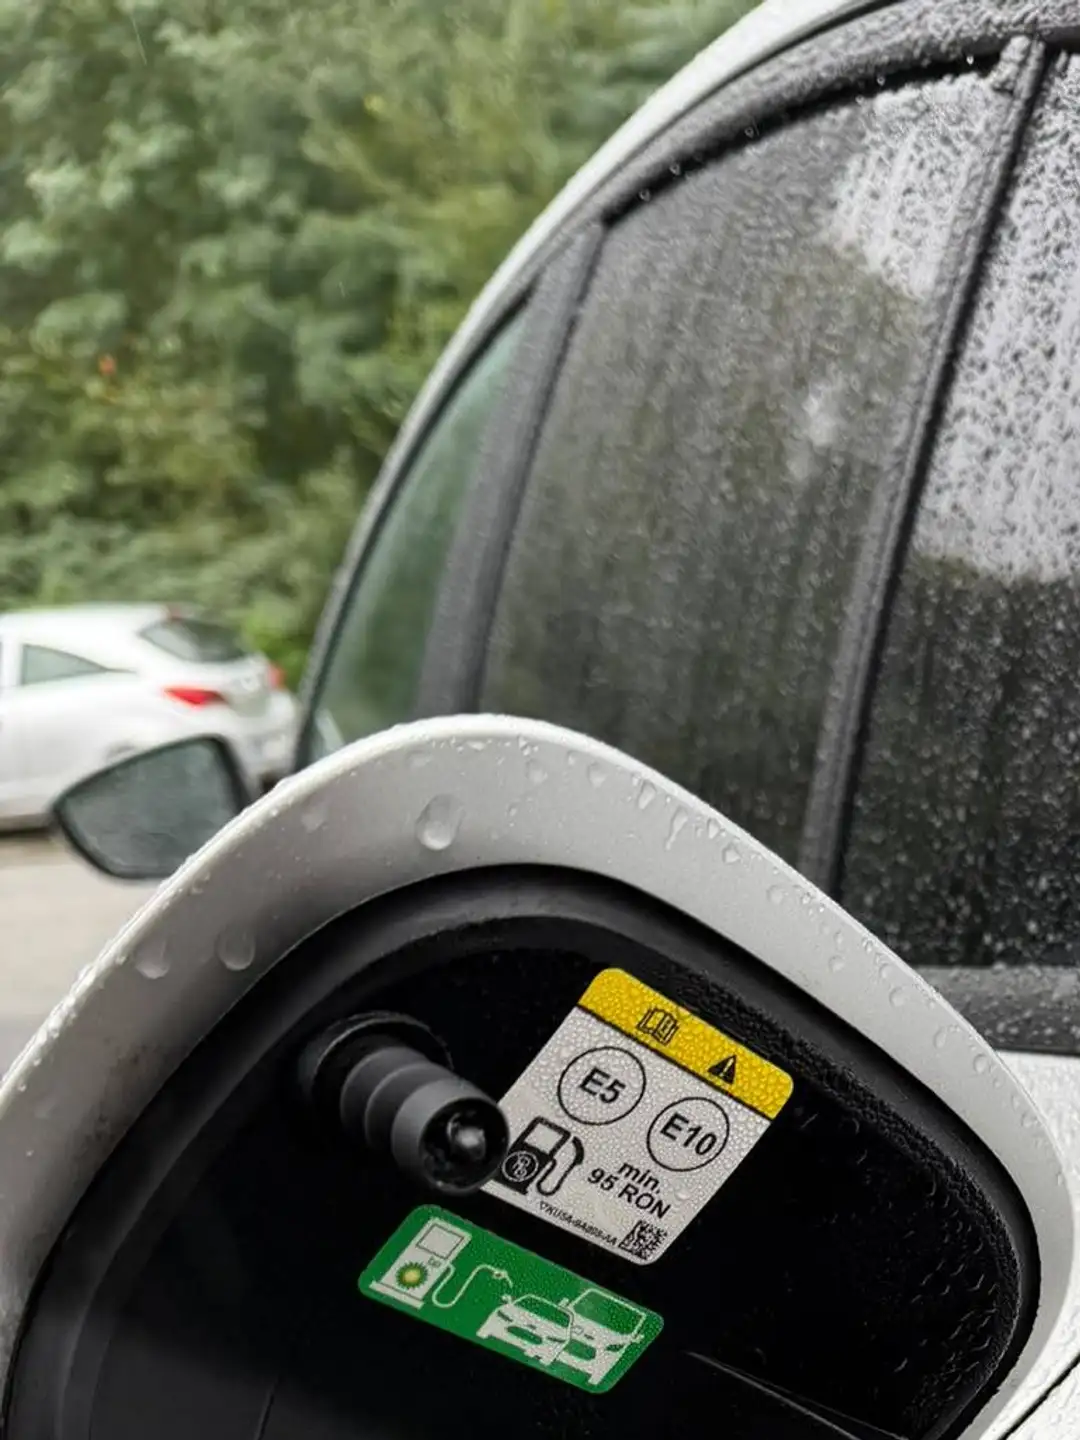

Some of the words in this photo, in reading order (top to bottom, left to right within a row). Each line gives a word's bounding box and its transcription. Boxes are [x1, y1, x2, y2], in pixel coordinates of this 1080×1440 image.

[579, 1067, 627, 1105] E5
[660, 1112, 718, 1157] E10
[587, 1167, 615, 1192] 95
[618, 1186, 672, 1219] RON
[616, 1162, 662, 1193] min.
